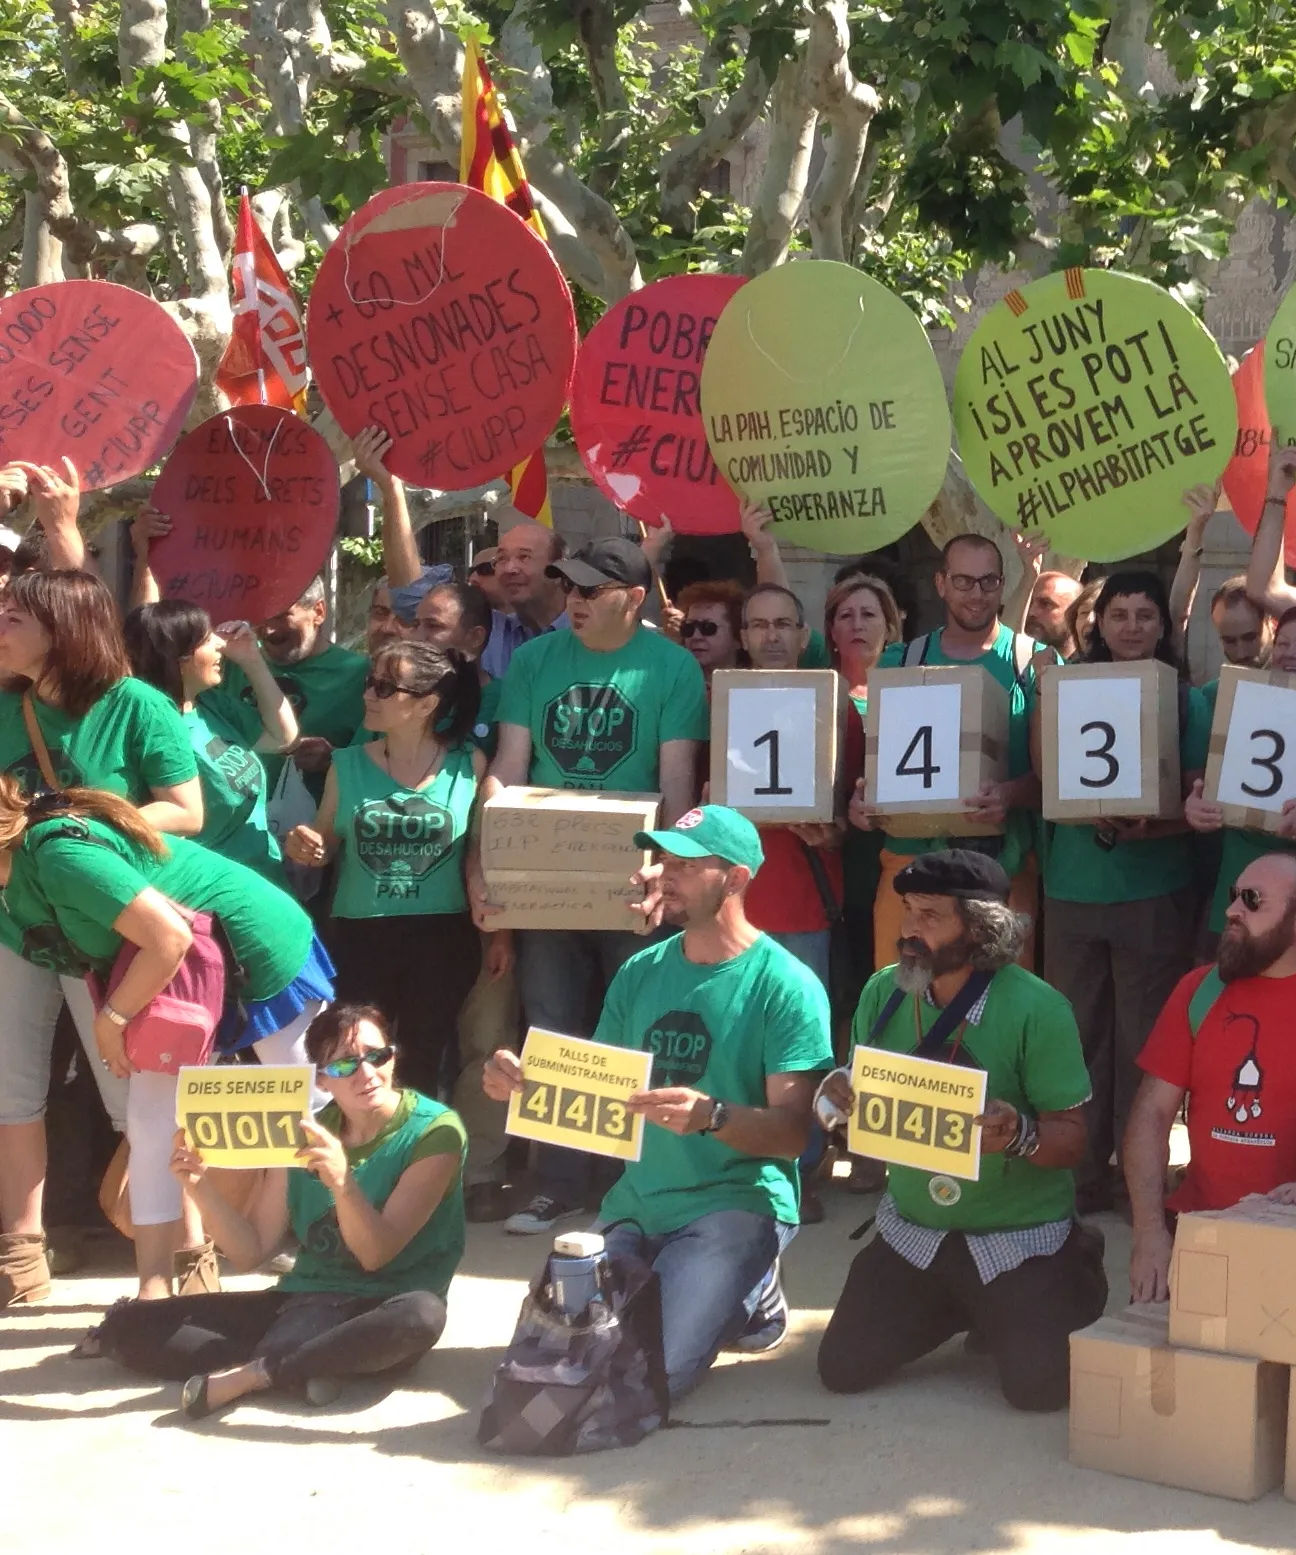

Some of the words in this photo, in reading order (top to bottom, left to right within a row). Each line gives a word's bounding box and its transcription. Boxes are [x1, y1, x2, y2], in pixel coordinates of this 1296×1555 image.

[352, 270, 394, 319] 60
[402, 242, 464, 296] MIL
[49, 304, 120, 376] SENSE
[331, 268, 541, 400] DESNONADES
[981, 340, 1020, 385] AL
[1022, 299, 1106, 364] JUNY
[61, 367, 128, 438] GENT
[368, 363, 472, 439] SENSE
[470, 333, 552, 401] CASA
[1027, 368, 1076, 420] ES
[419, 405, 527, 479] #CIUPP
[711, 415, 732, 443] LA
[869, 401, 897, 431] DE
[990, 395, 1135, 487] APROVEM
[1145, 370, 1198, 419] LA
[728, 445, 831, 483] COMUNIDAD
[843, 446, 859, 474] Y
[769, 487, 887, 522] ESPERANZA
[196, 525, 302, 552] HUMANS
[553, 704, 624, 736] STOP
[215, 745, 248, 776] STOP
[753, 729, 793, 796] 1
[895, 725, 941, 789] 4
[1078, 720, 1120, 788] 3
[1240, 729, 1286, 798] 3
[361, 811, 445, 839] STOP
[360, 842, 441, 856] DESAHUCIOS
[377, 884, 419, 898] PAH
[559, 1047, 590, 1064] TALLS
[591, 1056, 607, 1067] DE
[648, 1030, 705, 1059] STOP
[187, 1081, 222, 1095] DIES
[226, 1080, 276, 1094] SENSE
[280, 1080, 304, 1094] ILP
[527, 1055, 639, 1089] SUBMINISTRAMENTS
[862, 1065, 974, 1099] DESNONAMENTS
